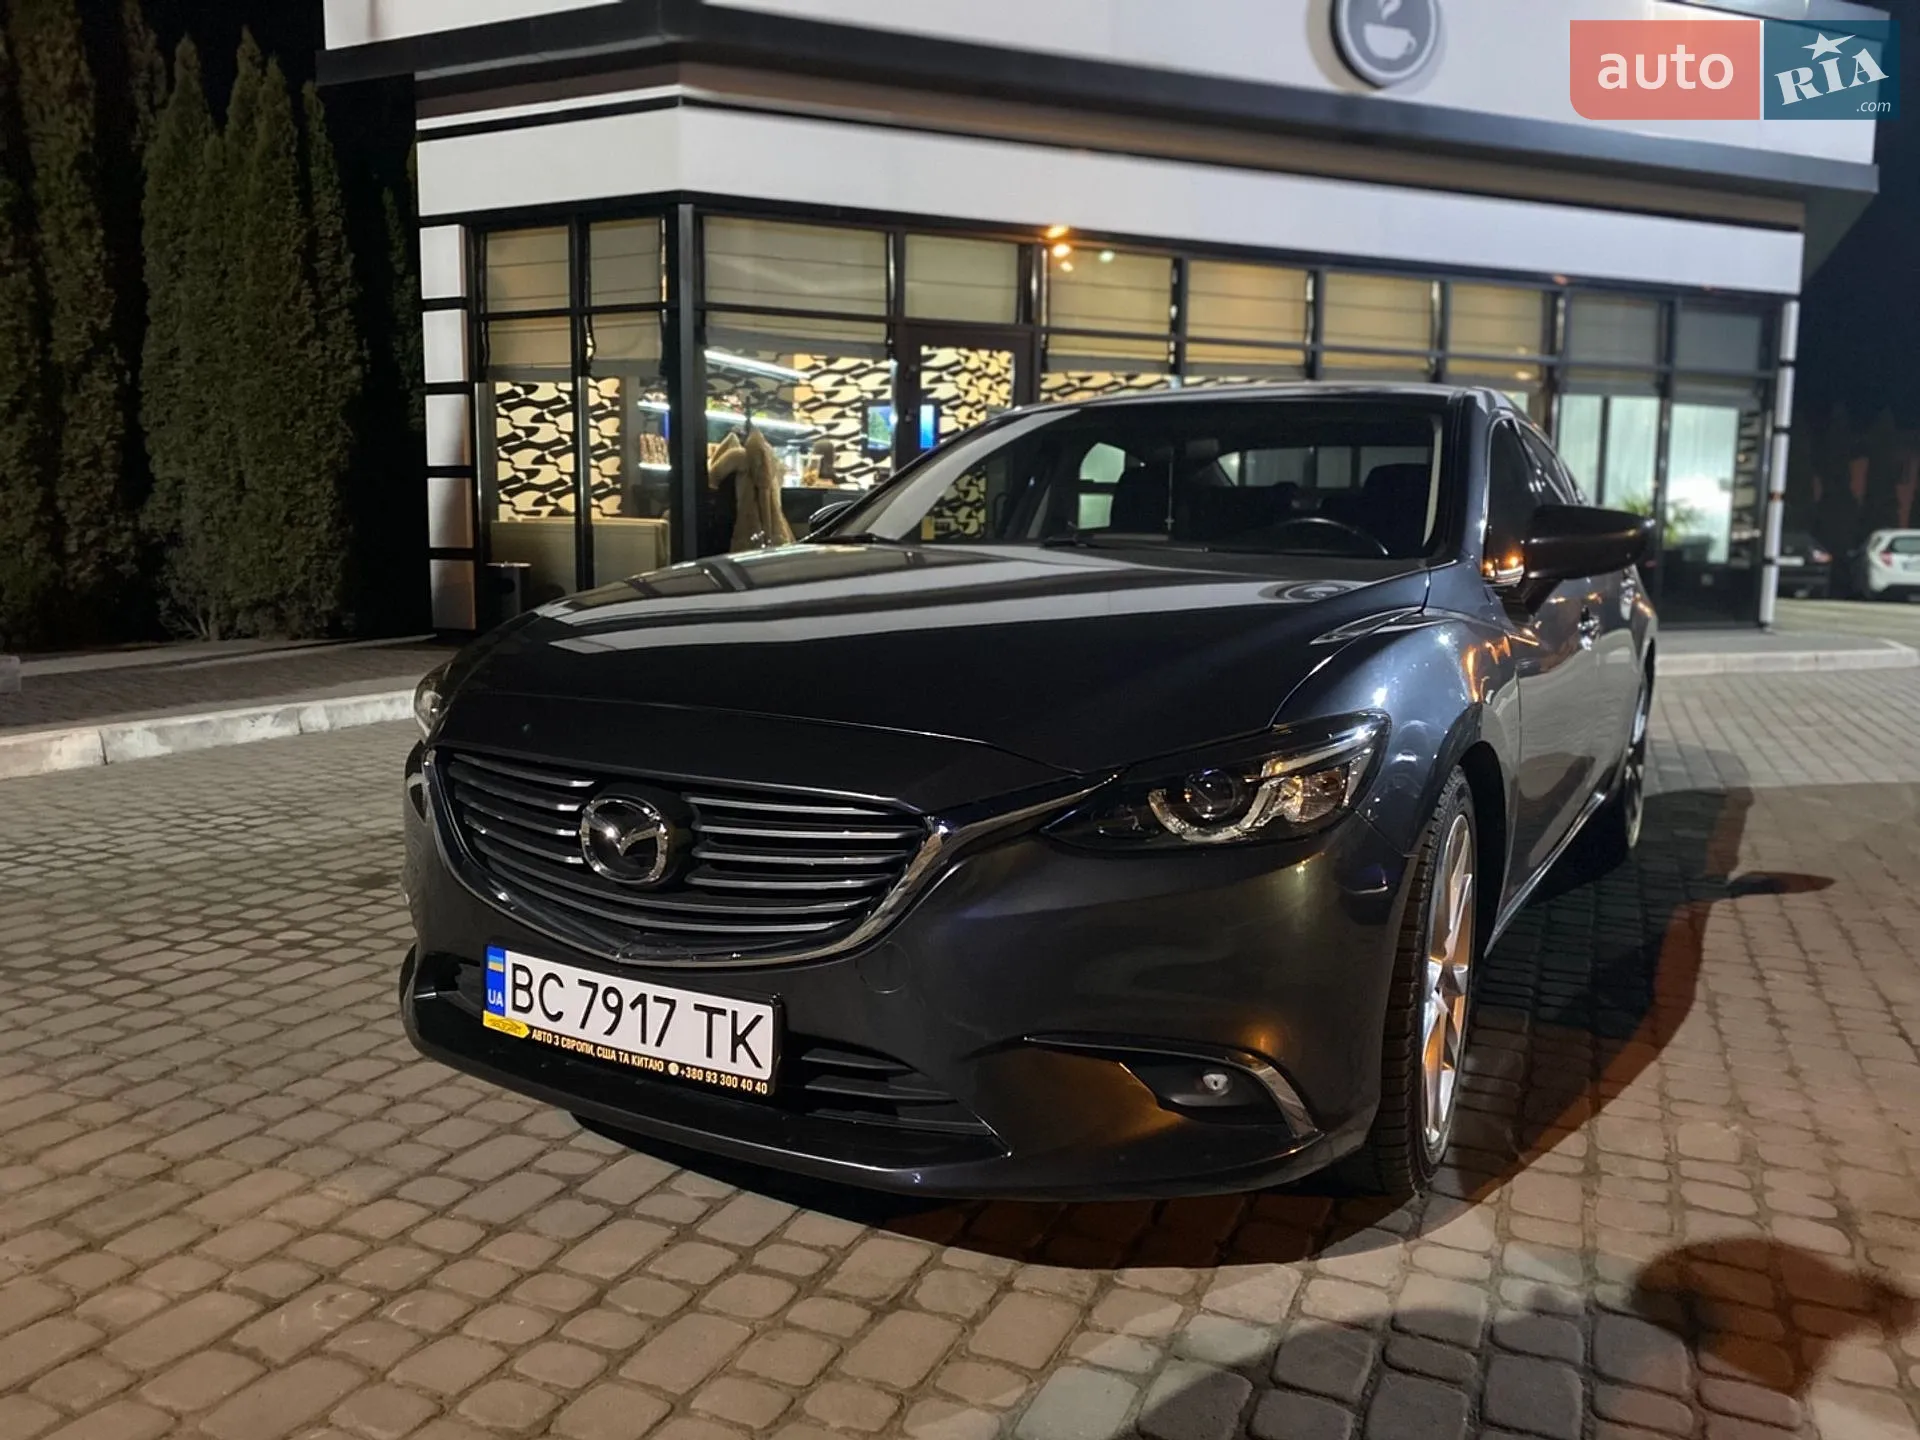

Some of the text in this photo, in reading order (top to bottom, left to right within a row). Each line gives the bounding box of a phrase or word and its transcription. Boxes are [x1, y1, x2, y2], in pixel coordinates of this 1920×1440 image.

[487, 989, 504, 1007] UA
[511, 963, 764, 1069] BC 7917 TK
[531, 1030, 552, 1045] АВТО
[597, 1047, 616, 1061] США
[619, 1052, 630, 1065] ТА
[631, 1055, 664, 1072] КИТАЮ
[680, 1066, 704, 1081] +380
[705, 1071, 718, 1083] 93
[720, 1074, 738, 1088] 300
[740, 1079, 753, 1091] 40
[755, 1082, 767, 1094] 40
